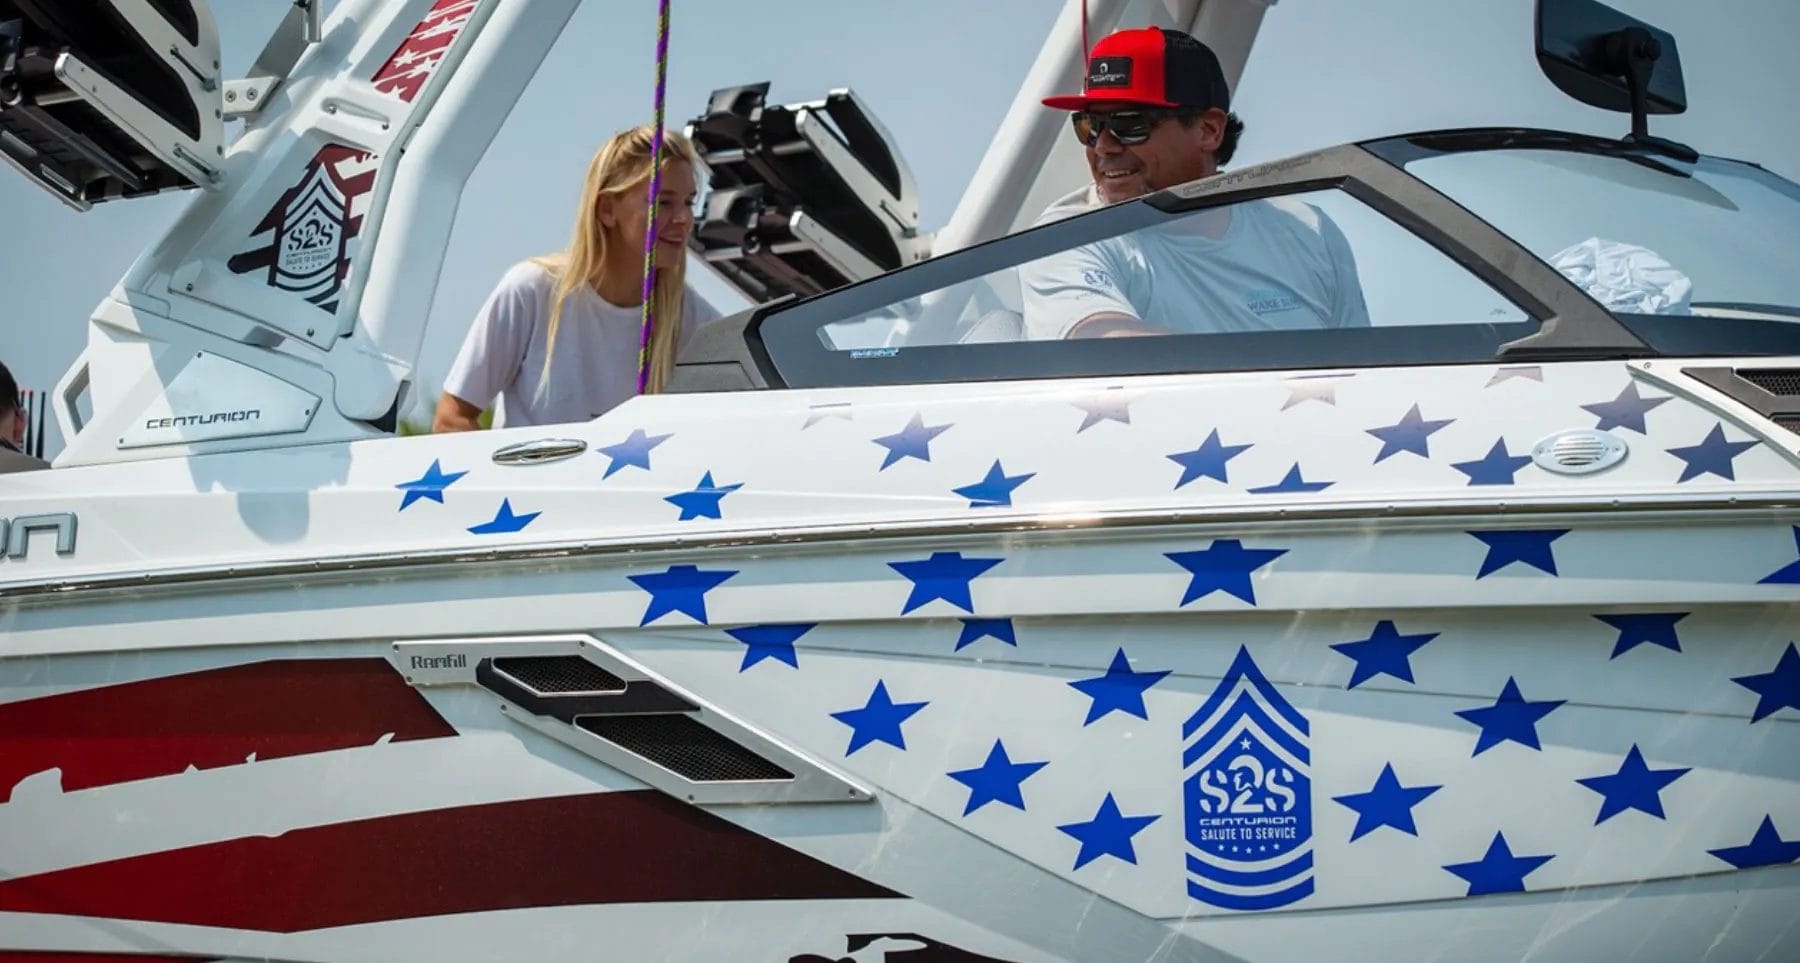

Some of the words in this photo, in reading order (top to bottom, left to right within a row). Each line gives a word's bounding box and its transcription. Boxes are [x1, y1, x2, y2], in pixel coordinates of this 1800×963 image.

[288, 219, 333, 250] S2S
[146, 409, 260, 429] CENTURION
[1200, 755, 1296, 814] S2S
[1199, 816, 1297, 826] CENTURION
[1201, 828, 1236, 840] SALUTE
[1240, 828, 1253, 840] TO
[1256, 827, 1296, 839] SERVICE
